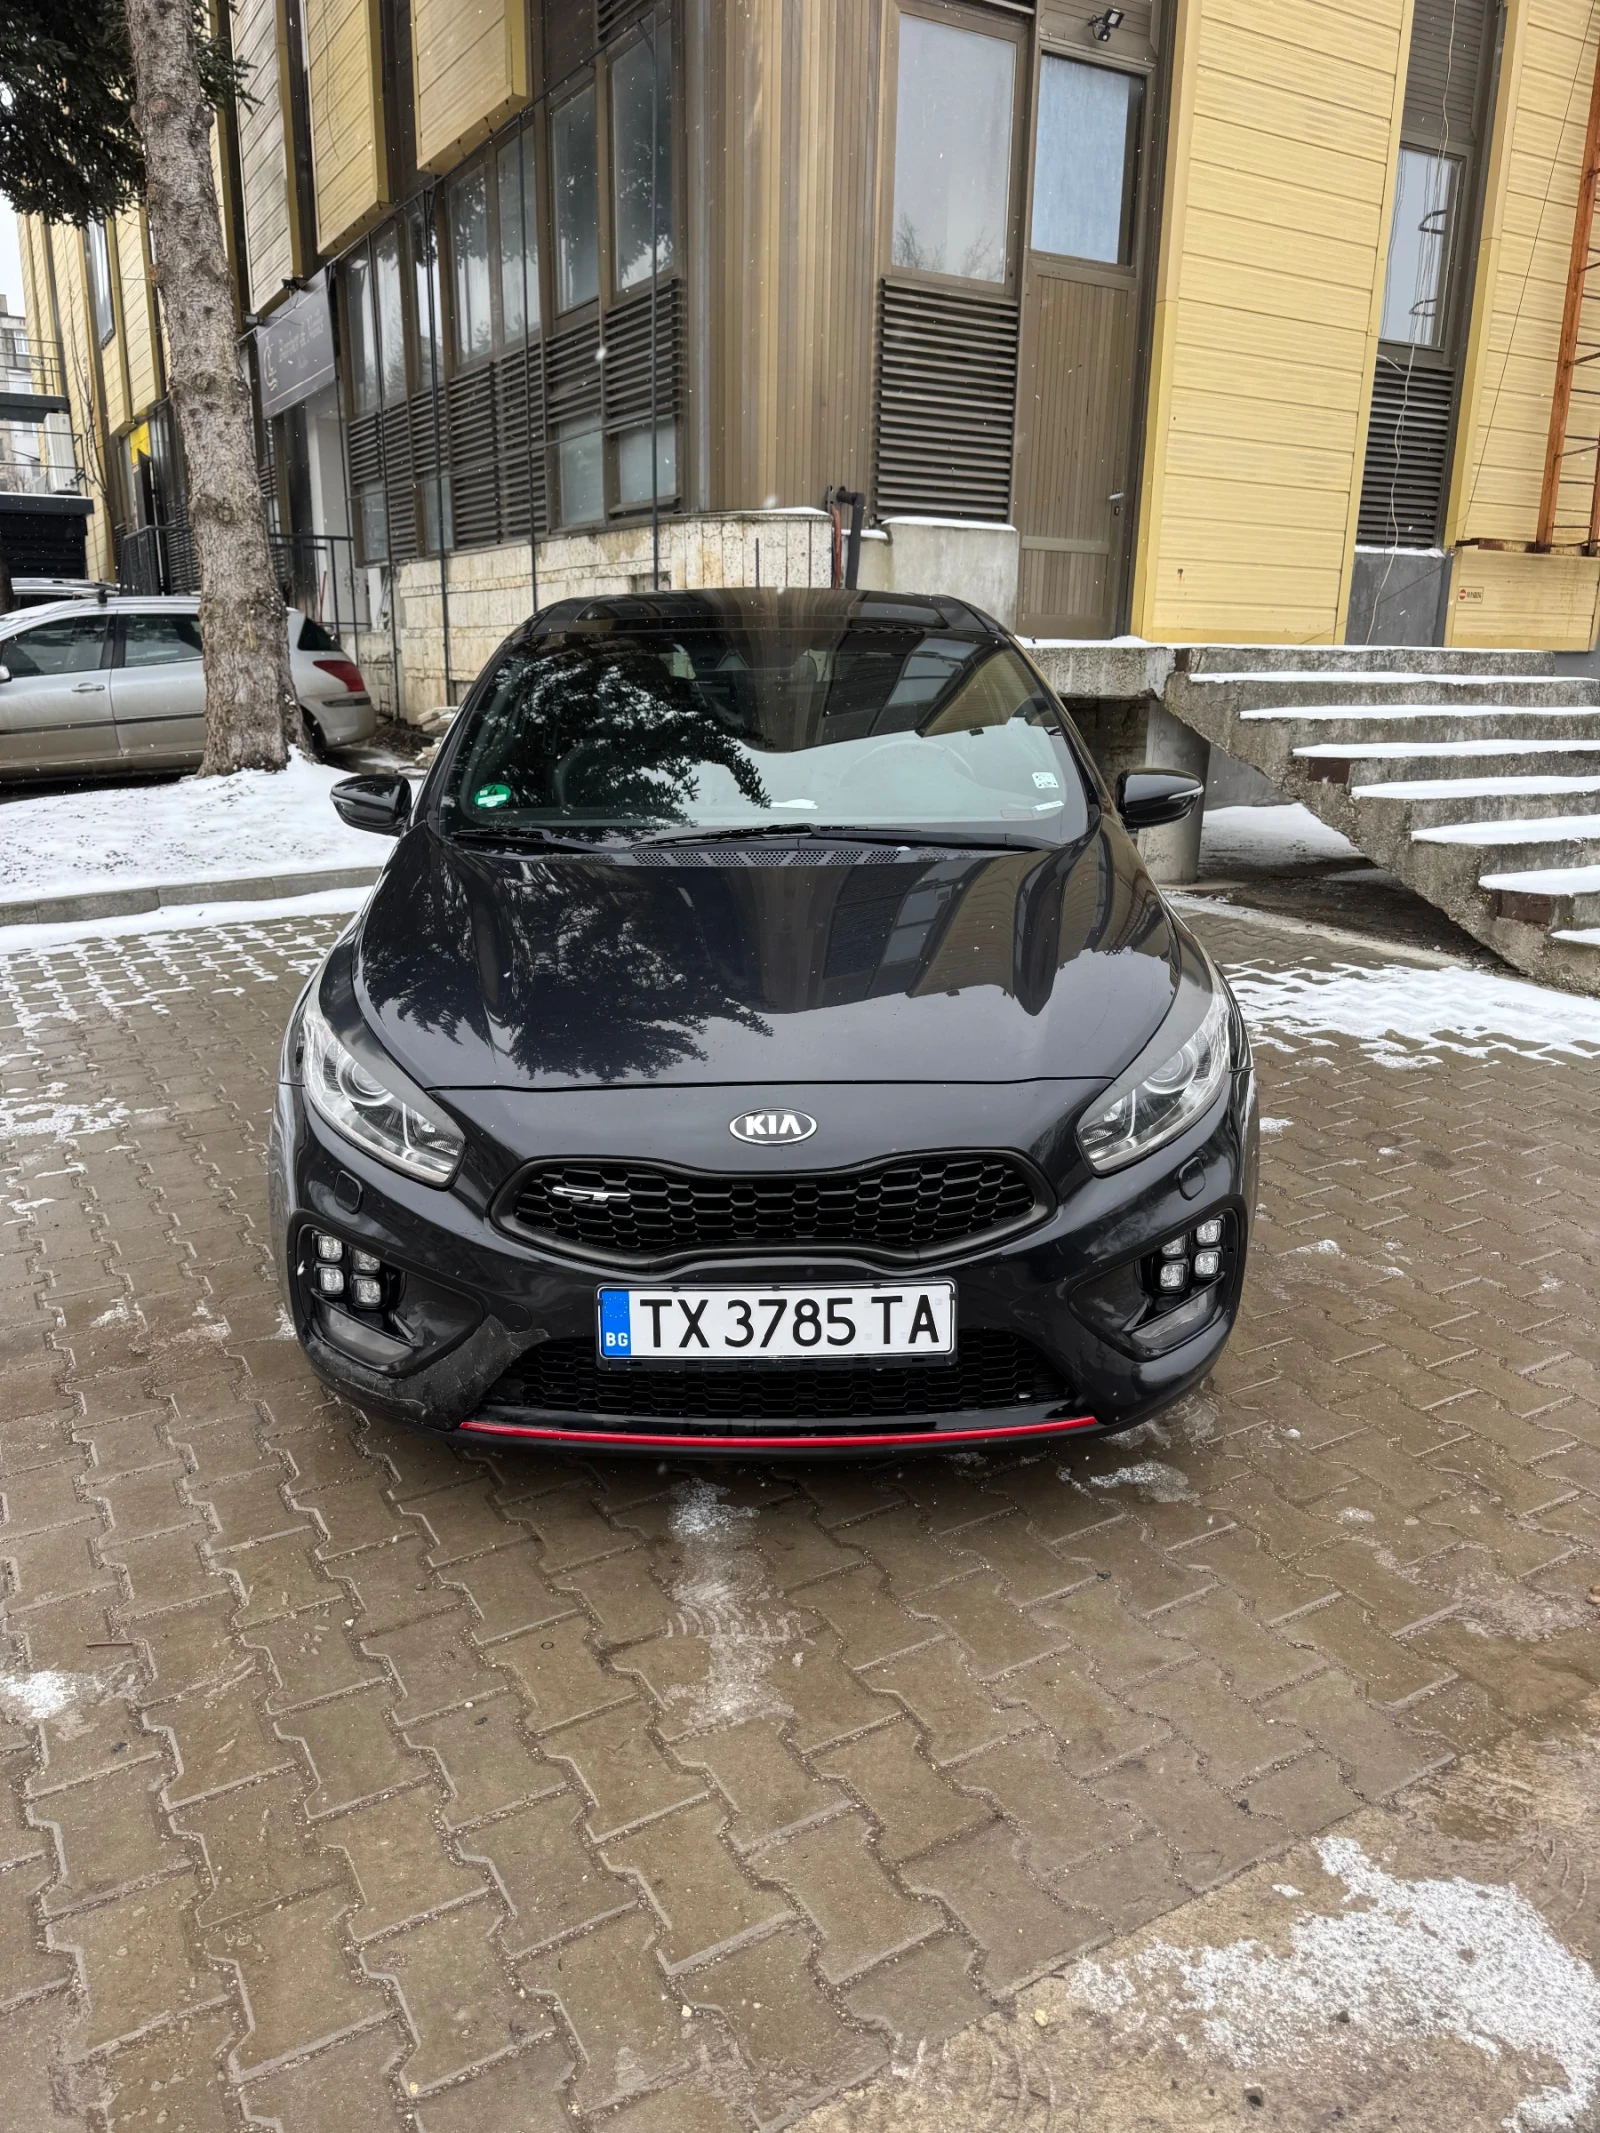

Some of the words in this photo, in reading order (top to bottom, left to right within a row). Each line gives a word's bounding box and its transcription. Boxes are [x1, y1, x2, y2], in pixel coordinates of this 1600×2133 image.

[745, 1114, 802, 1135] KIA
[639, 1298, 710, 1348] TX
[724, 1298, 857, 1348] 3785
[870, 1294, 940, 1345] TA
[605, 1332, 629, 1347] BG
